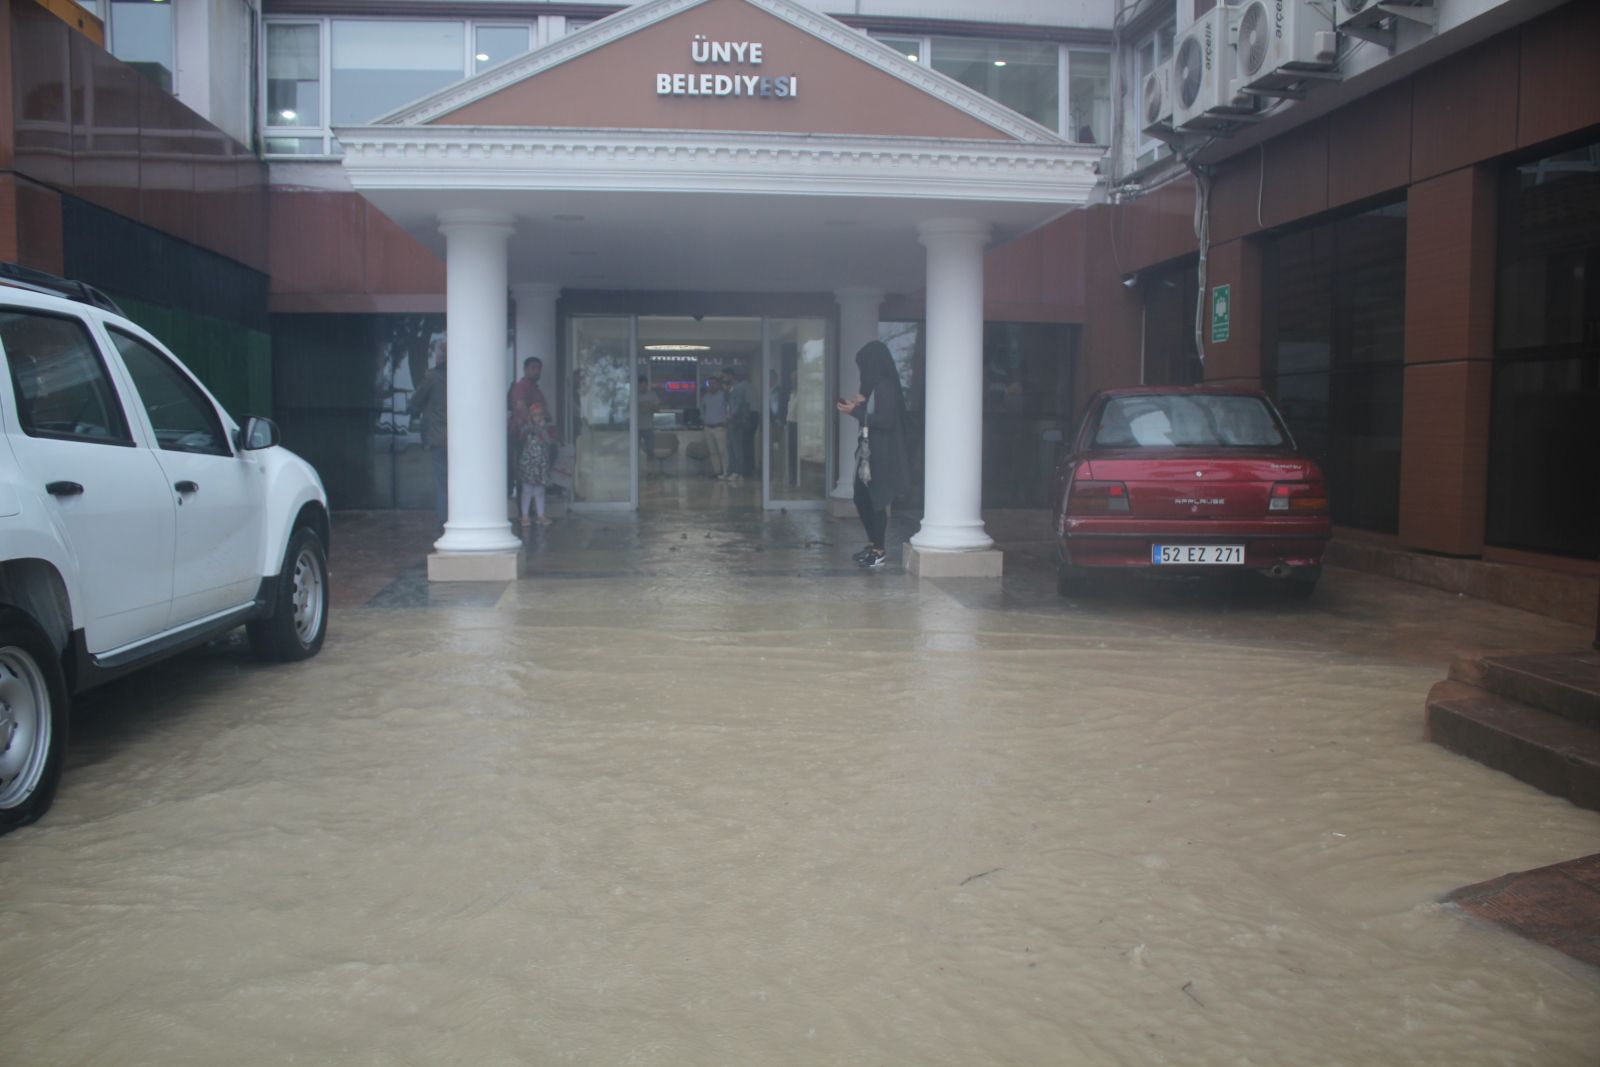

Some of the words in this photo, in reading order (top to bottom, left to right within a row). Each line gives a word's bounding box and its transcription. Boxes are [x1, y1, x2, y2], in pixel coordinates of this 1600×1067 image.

[691, 34, 763, 63] ÜNYE
[656, 72, 797, 97] BELEDİYESİ
[1162, 547, 1180, 562] 52
[1188, 547, 1206, 562] EZ
[1215, 547, 1241, 562] 271
